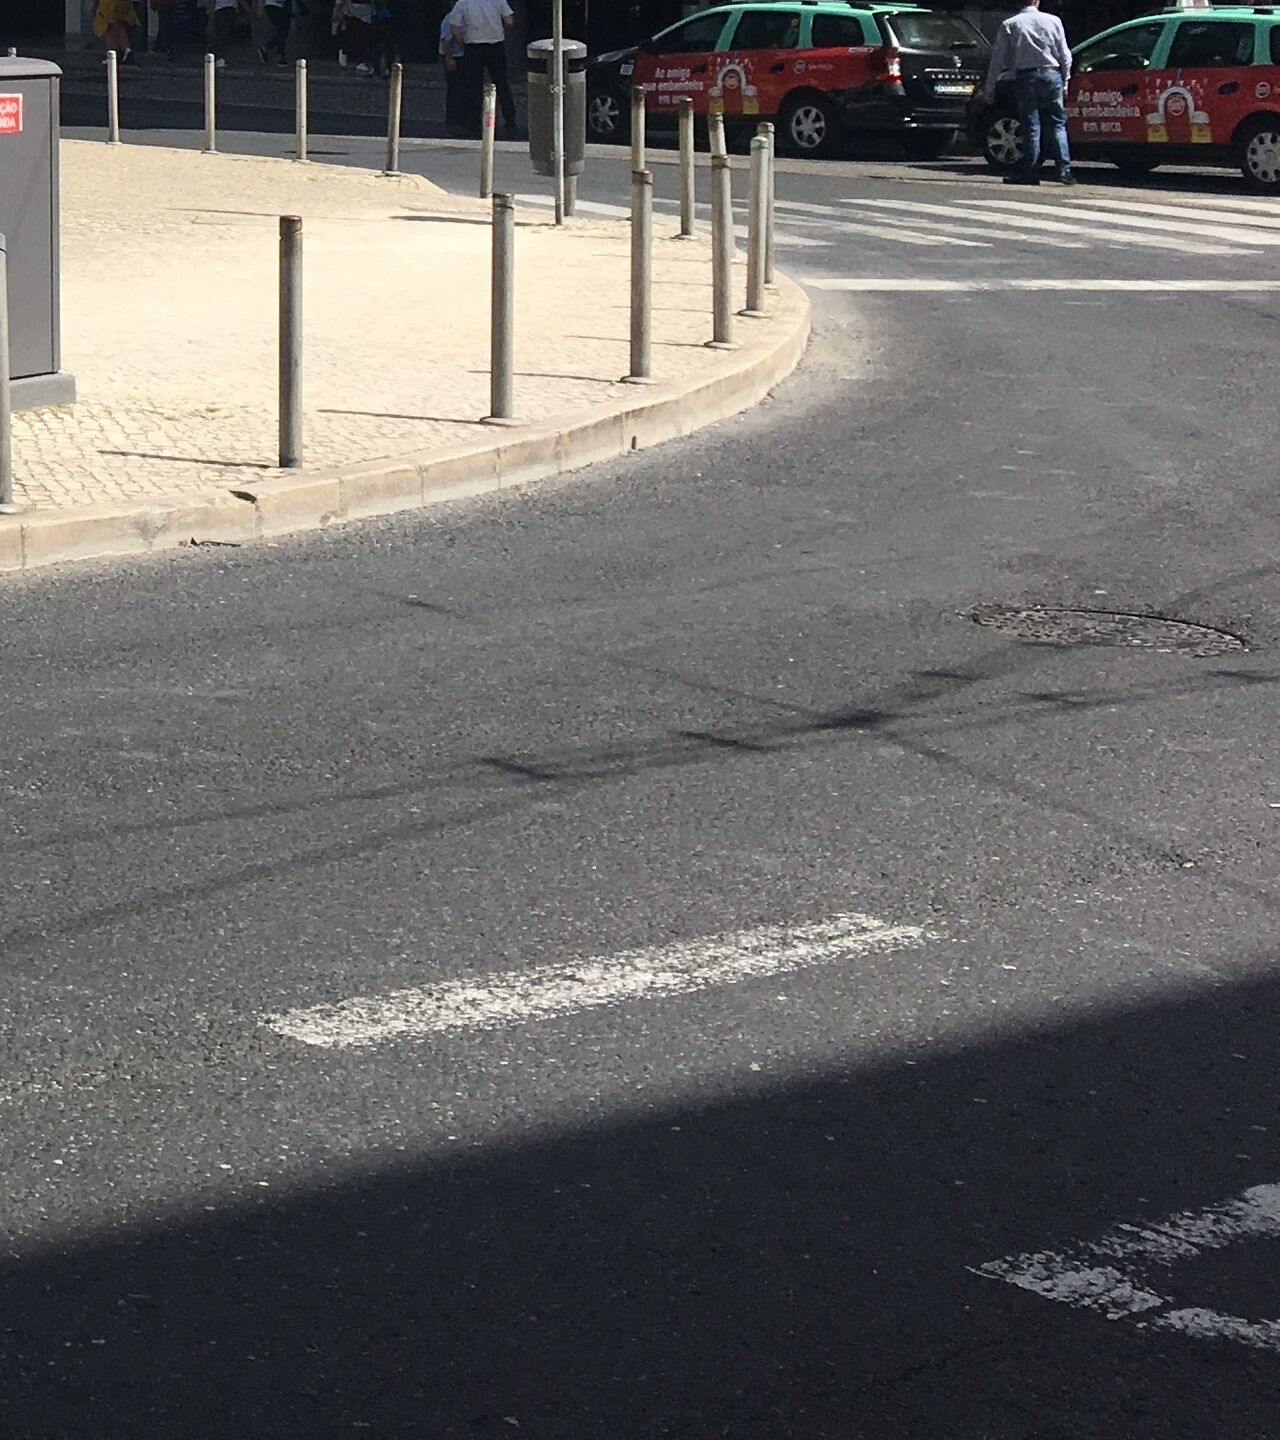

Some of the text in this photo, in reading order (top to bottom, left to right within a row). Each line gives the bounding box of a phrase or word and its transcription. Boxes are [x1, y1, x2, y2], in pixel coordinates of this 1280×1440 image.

[1077, 89, 1124, 106] Ao amigo
[1100, 122, 1122, 132] arco
